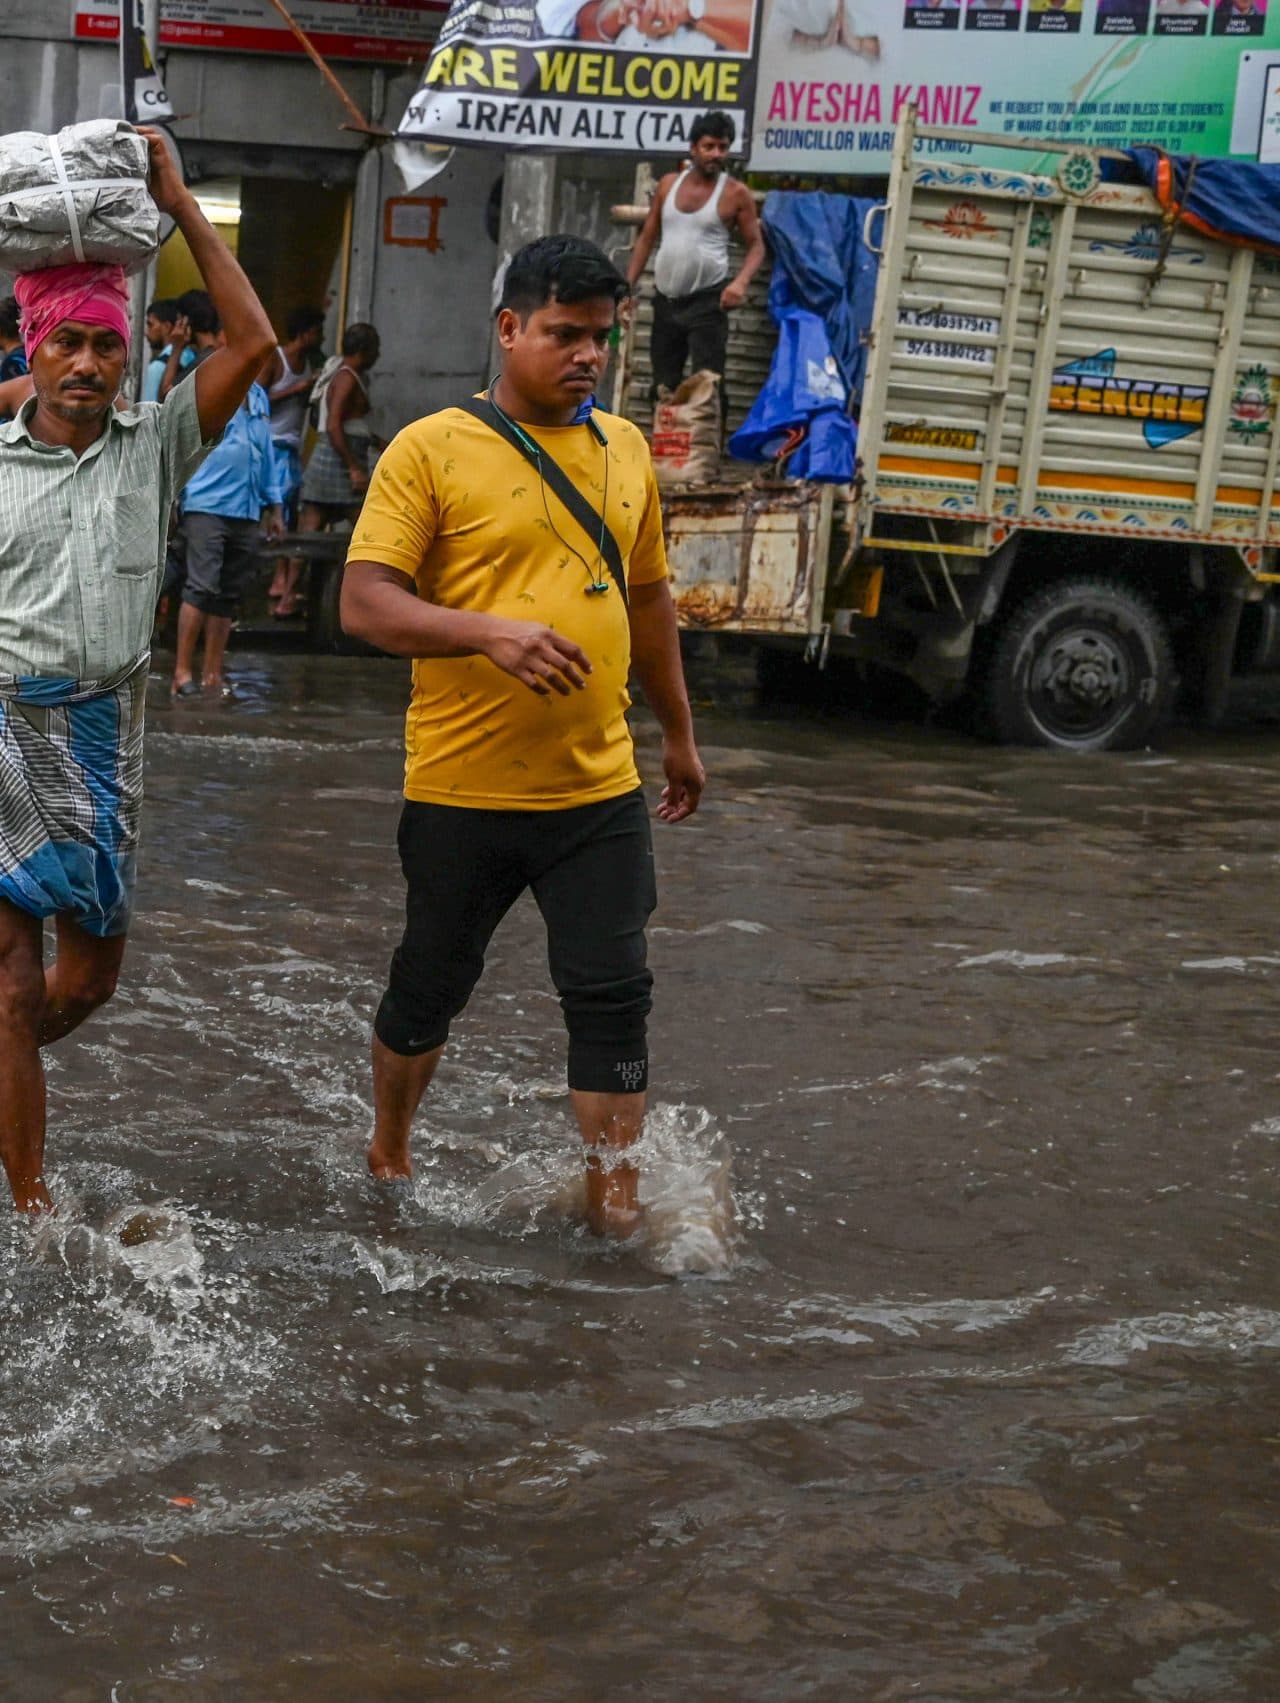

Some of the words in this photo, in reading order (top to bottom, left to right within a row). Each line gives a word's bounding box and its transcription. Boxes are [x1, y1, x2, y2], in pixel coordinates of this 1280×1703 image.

[424, 47, 519, 91] ARE
[533, 51, 741, 102] WELCOME
[767, 81, 882, 124] AYESHA
[891, 84, 982, 126] KANIZ
[457, 98, 562, 137] IRFAN
[571, 108, 626, 140] ALI
[765, 129, 854, 151] COUNCILLOR
[858, 131, 896, 152] WAR
[613, 1060, 645, 1071] JUST
[622, 1071, 642, 1080] DO
[625, 1080, 639, 1089] IT
